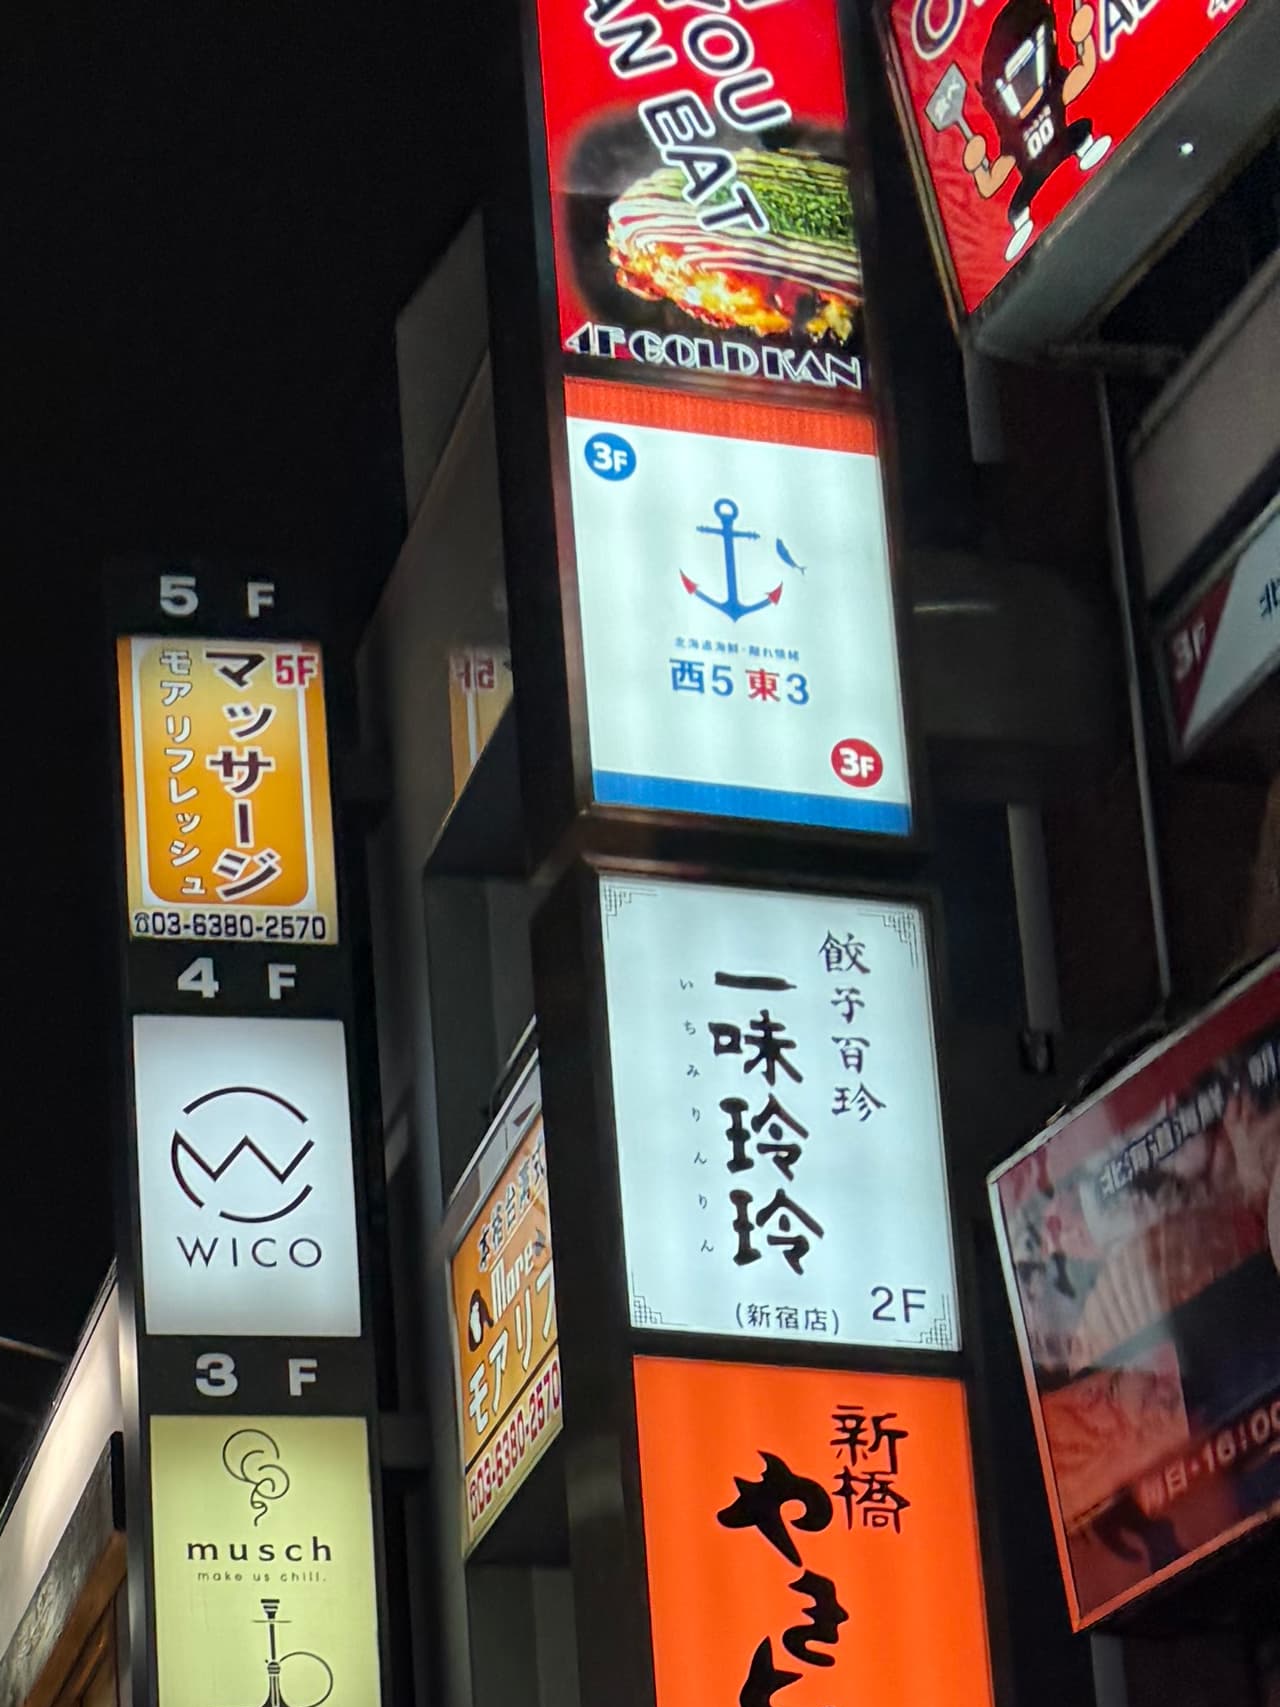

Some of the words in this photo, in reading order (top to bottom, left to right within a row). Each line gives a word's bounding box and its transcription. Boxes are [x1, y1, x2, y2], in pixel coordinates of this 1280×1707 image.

[639, 90, 770, 234] EAT
[629, 331, 760, 377] GOLD
[762, 346, 863, 391] KAN
[592, 443, 628, 473] 3F
[275, 655, 317, 685] 5F
[160, 650, 205, 896] モアリフレッシュ
[205, 649, 282, 903] マッサージ
[840, 748, 875, 778] 3F
[819, 929, 888, 1123] 餃子百珍
[679, 977, 715, 1255] いちみりんりん
[707, 971, 825, 1276] 一味玲玲
[177, 1236, 322, 1269] WICO
[735, 1303, 840, 1337] (新宿店)
[871, 1286, 927, 1324] 2F
[830, 1404, 911, 1534] 新橋
[186, 1535, 334, 1565] musch
[197, 1569, 245, 1582] make
[252, 1571, 273, 1582] us
